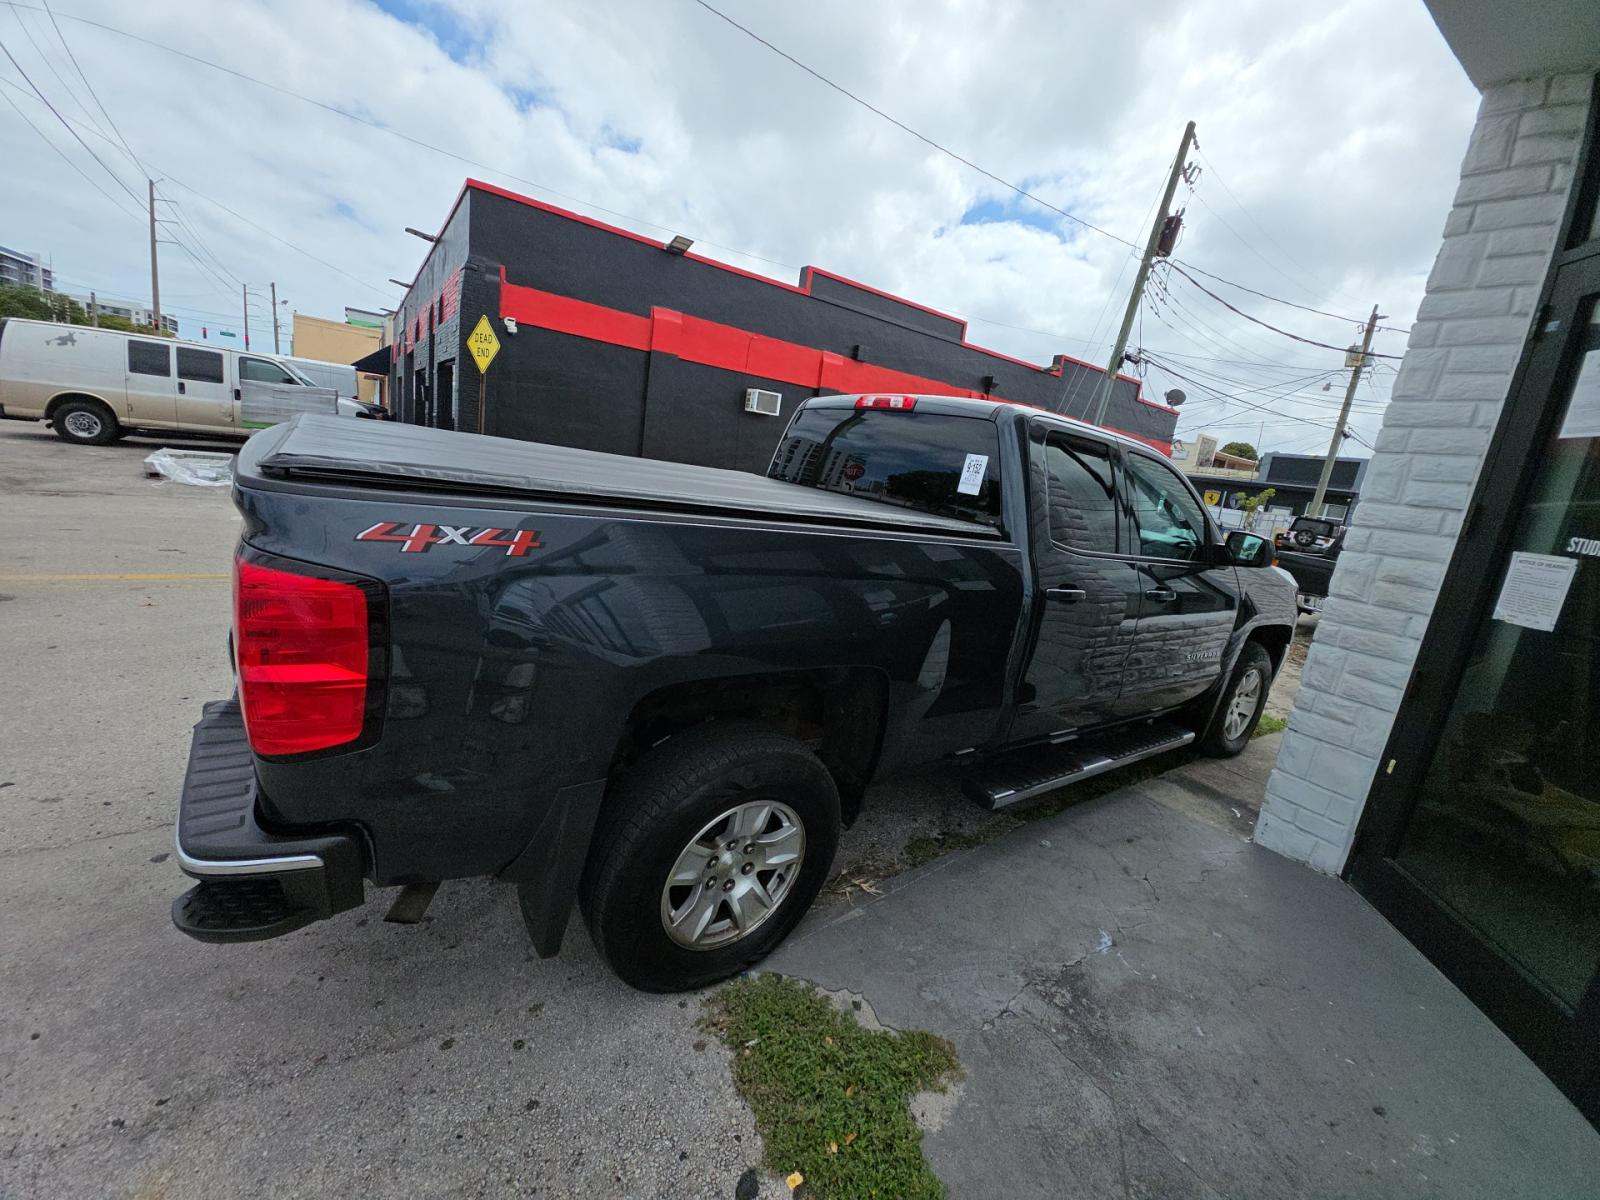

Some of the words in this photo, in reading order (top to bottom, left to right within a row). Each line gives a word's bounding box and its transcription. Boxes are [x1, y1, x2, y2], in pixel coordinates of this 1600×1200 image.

[474, 333, 493, 344] DEAD
[476, 347, 490, 358] END
[1567, 537, 1600, 557] STUD
